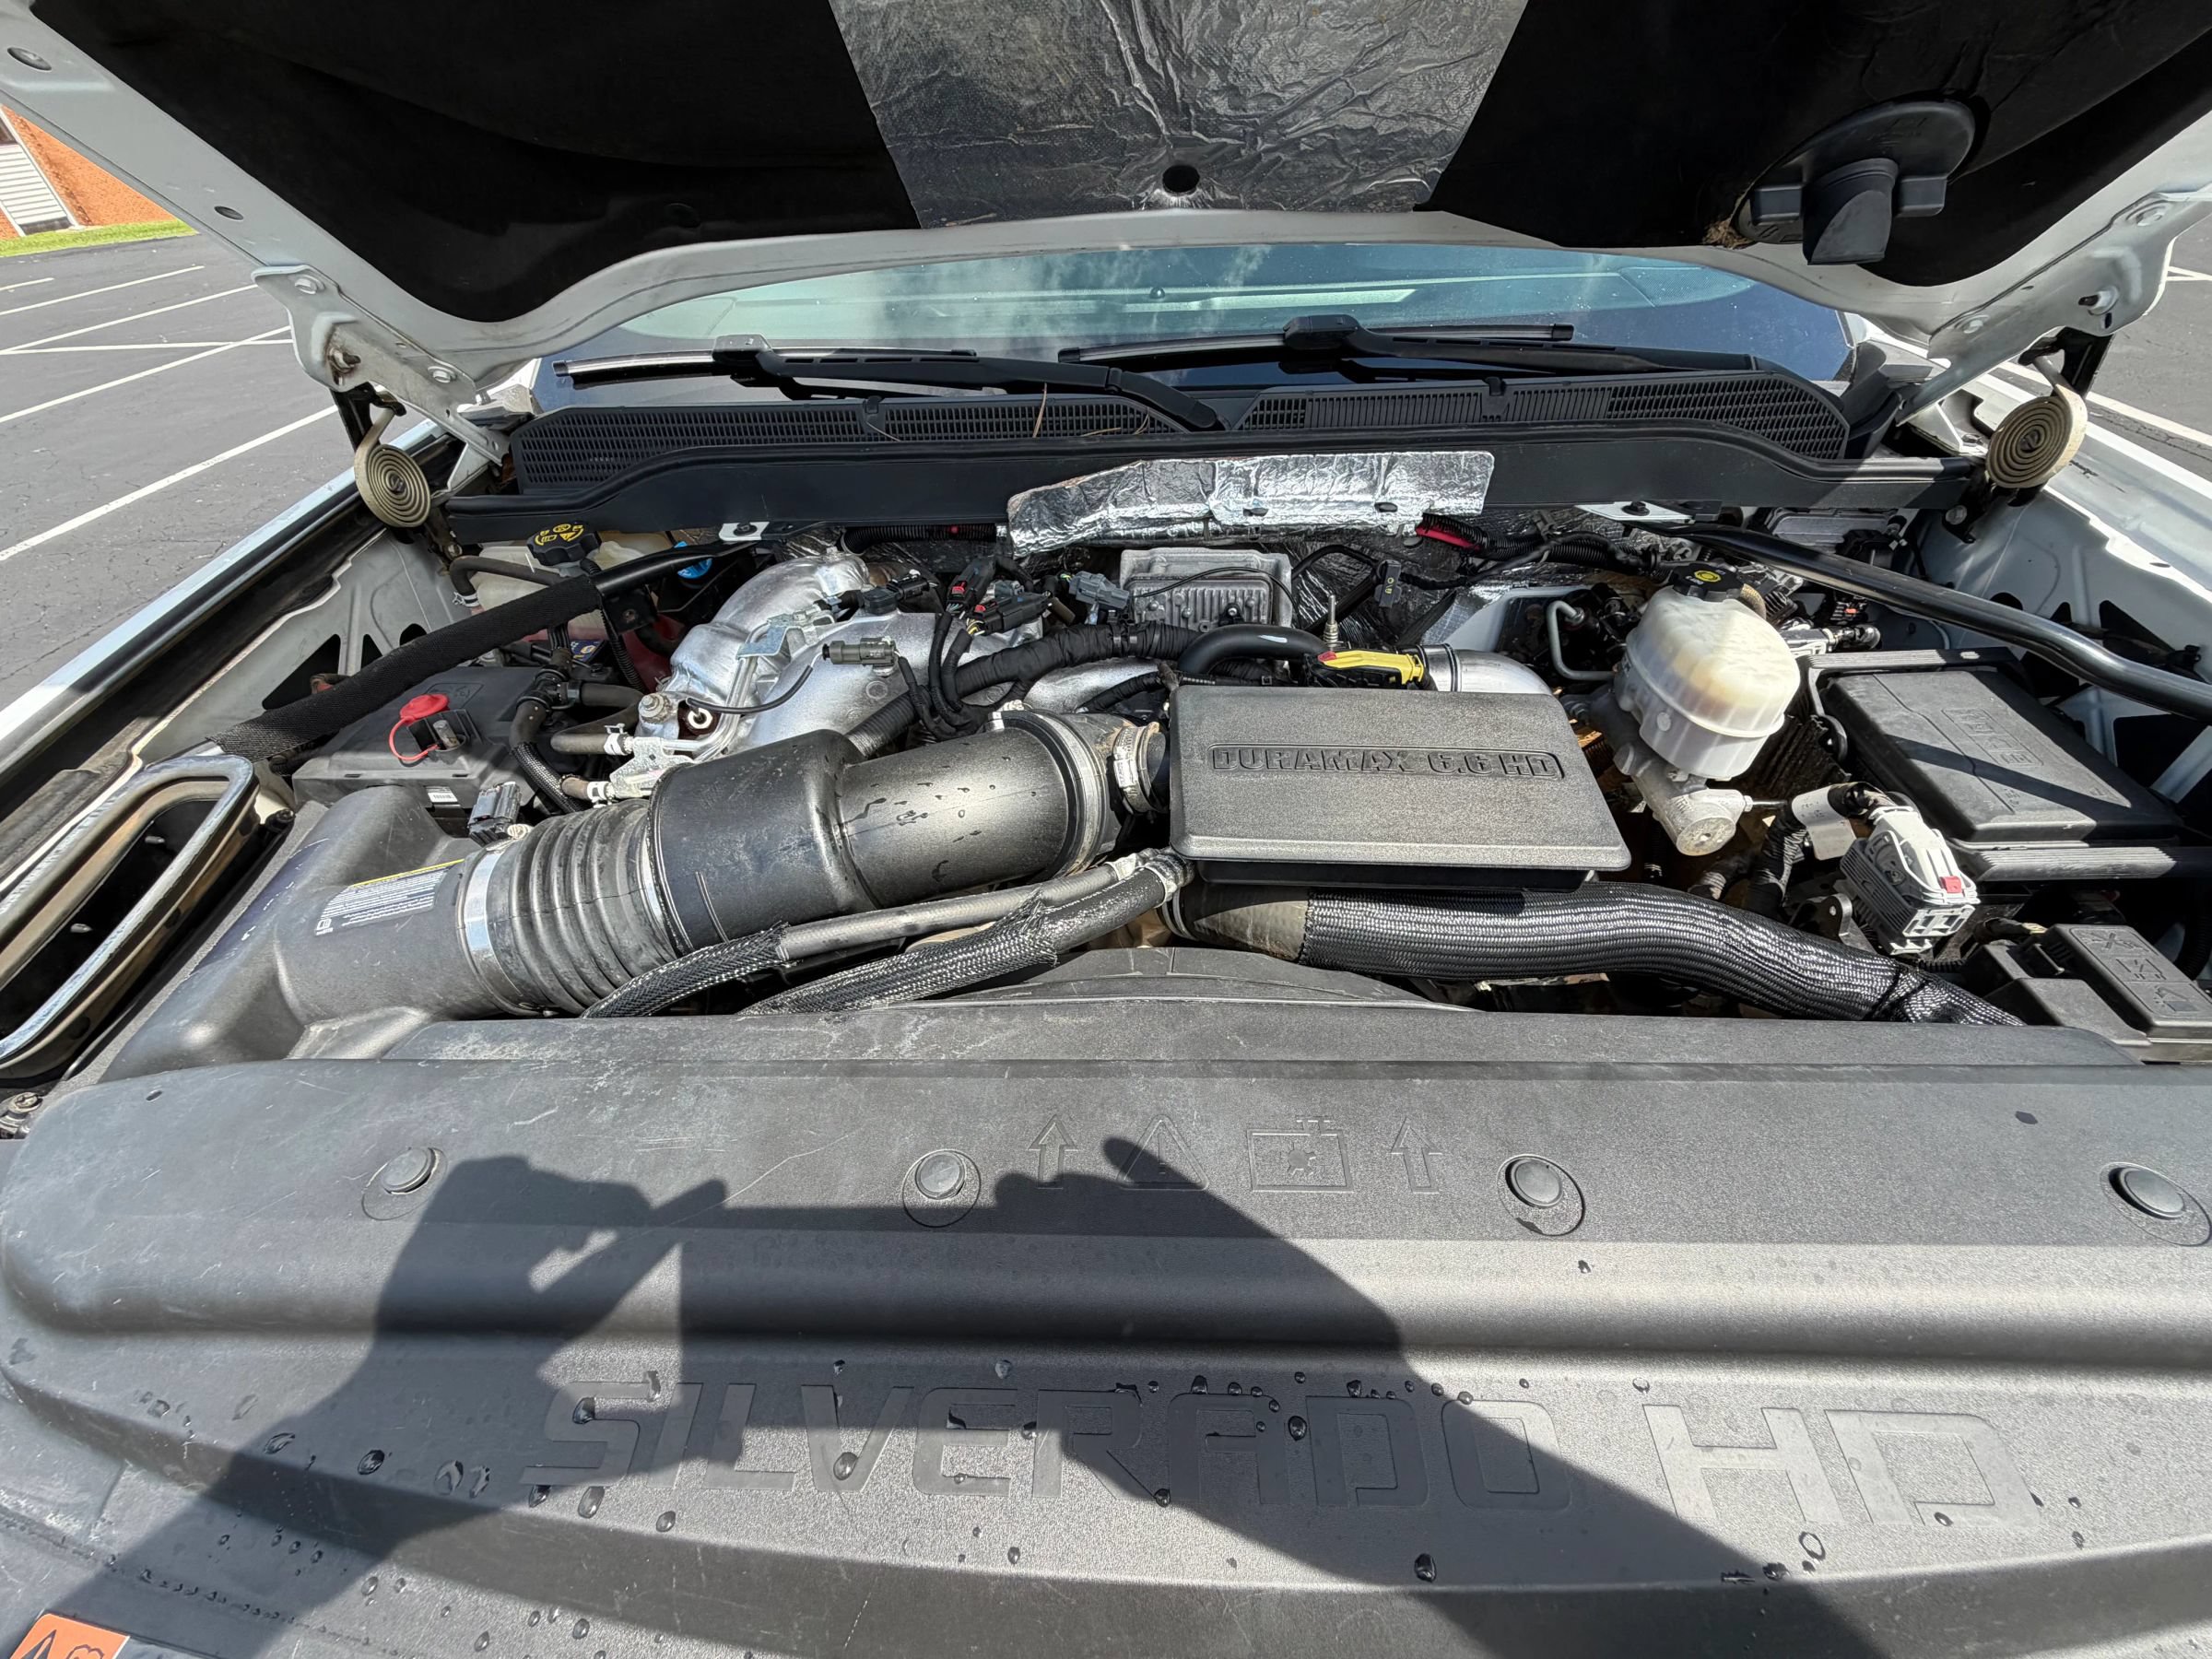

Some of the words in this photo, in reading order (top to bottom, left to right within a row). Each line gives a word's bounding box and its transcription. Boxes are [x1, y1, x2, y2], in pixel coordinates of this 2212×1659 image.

[1211, 748, 1416, 774] DURAMAX
[1427, 751, 1494, 776] 6.6
[1500, 754, 1559, 779] HD
[521, 1382, 1571, 1512] SILVERADO
[1642, 1404, 2041, 1527] HD
